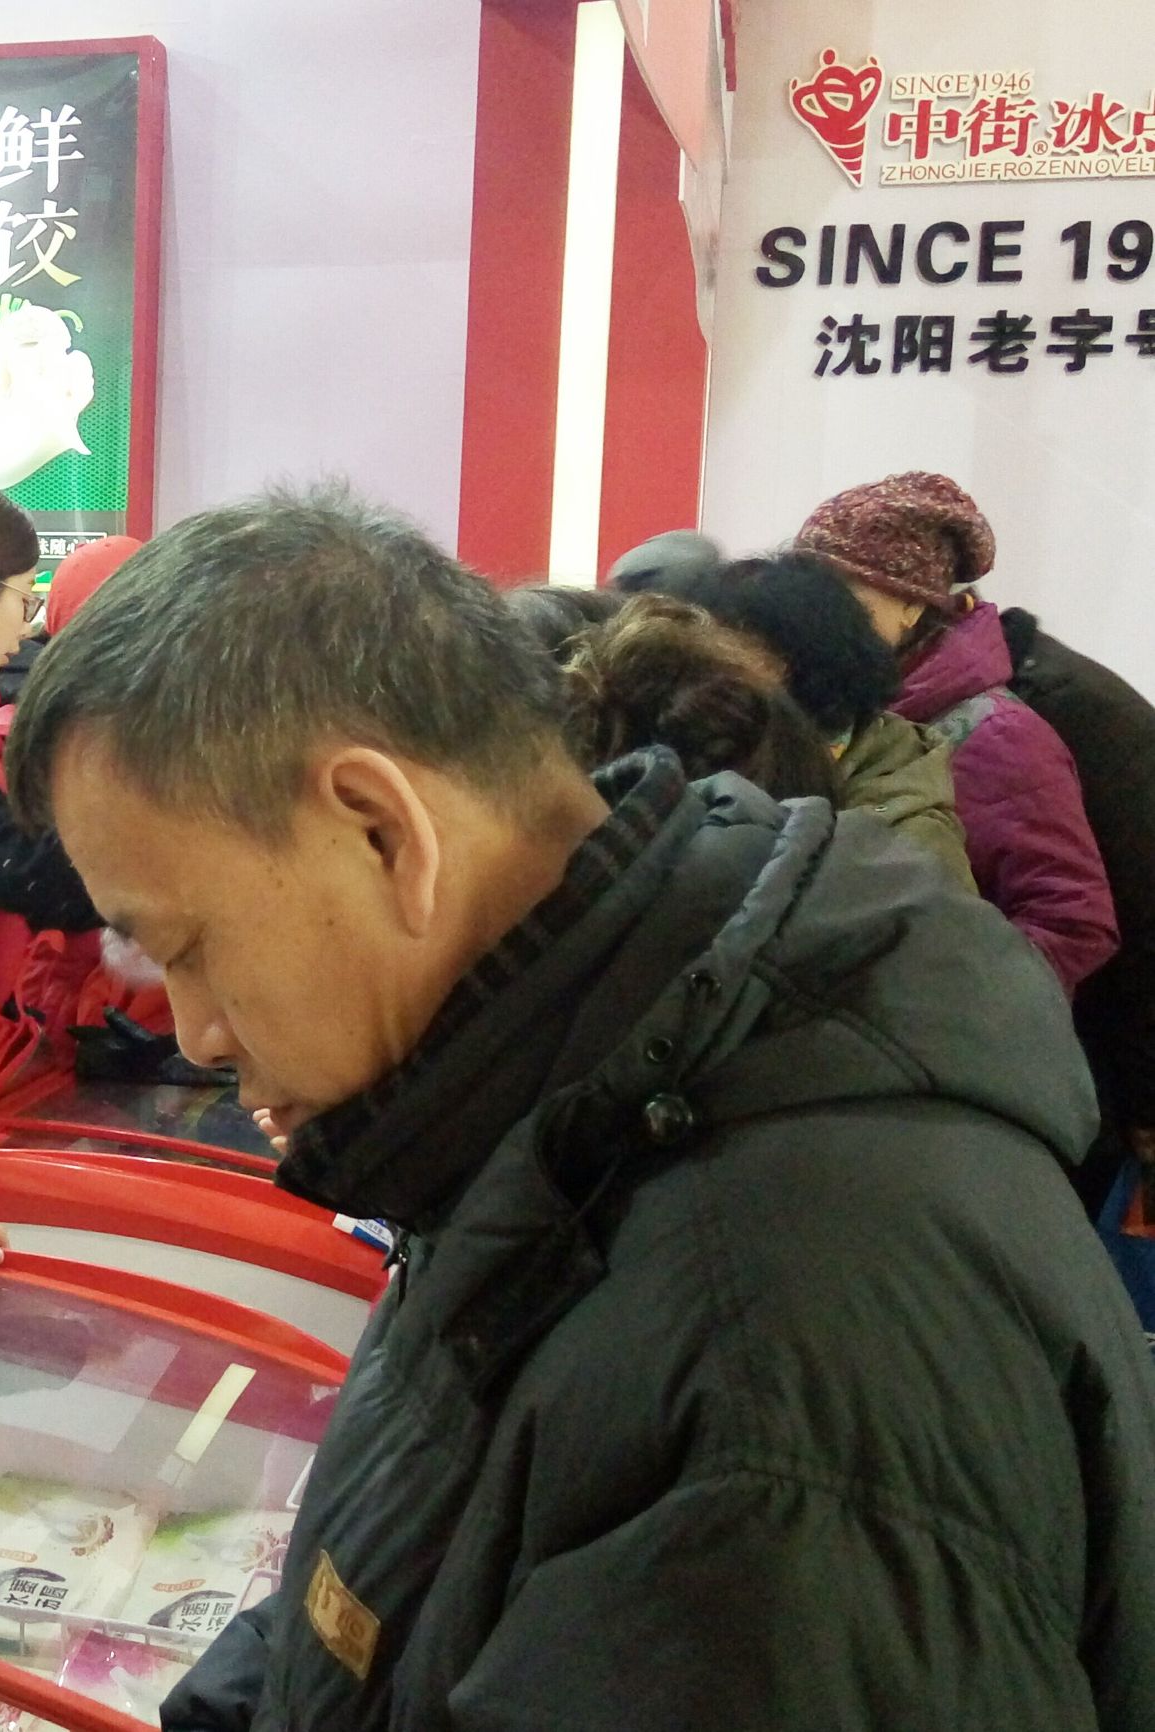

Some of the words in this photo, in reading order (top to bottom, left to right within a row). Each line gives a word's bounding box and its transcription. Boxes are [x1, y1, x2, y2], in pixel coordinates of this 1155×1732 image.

[894, 73, 972, 97] SINCE
[979, 71, 1031, 93] 1946
[754, 218, 1026, 289] SINCE
[1060, 218, 1154, 283] 19
